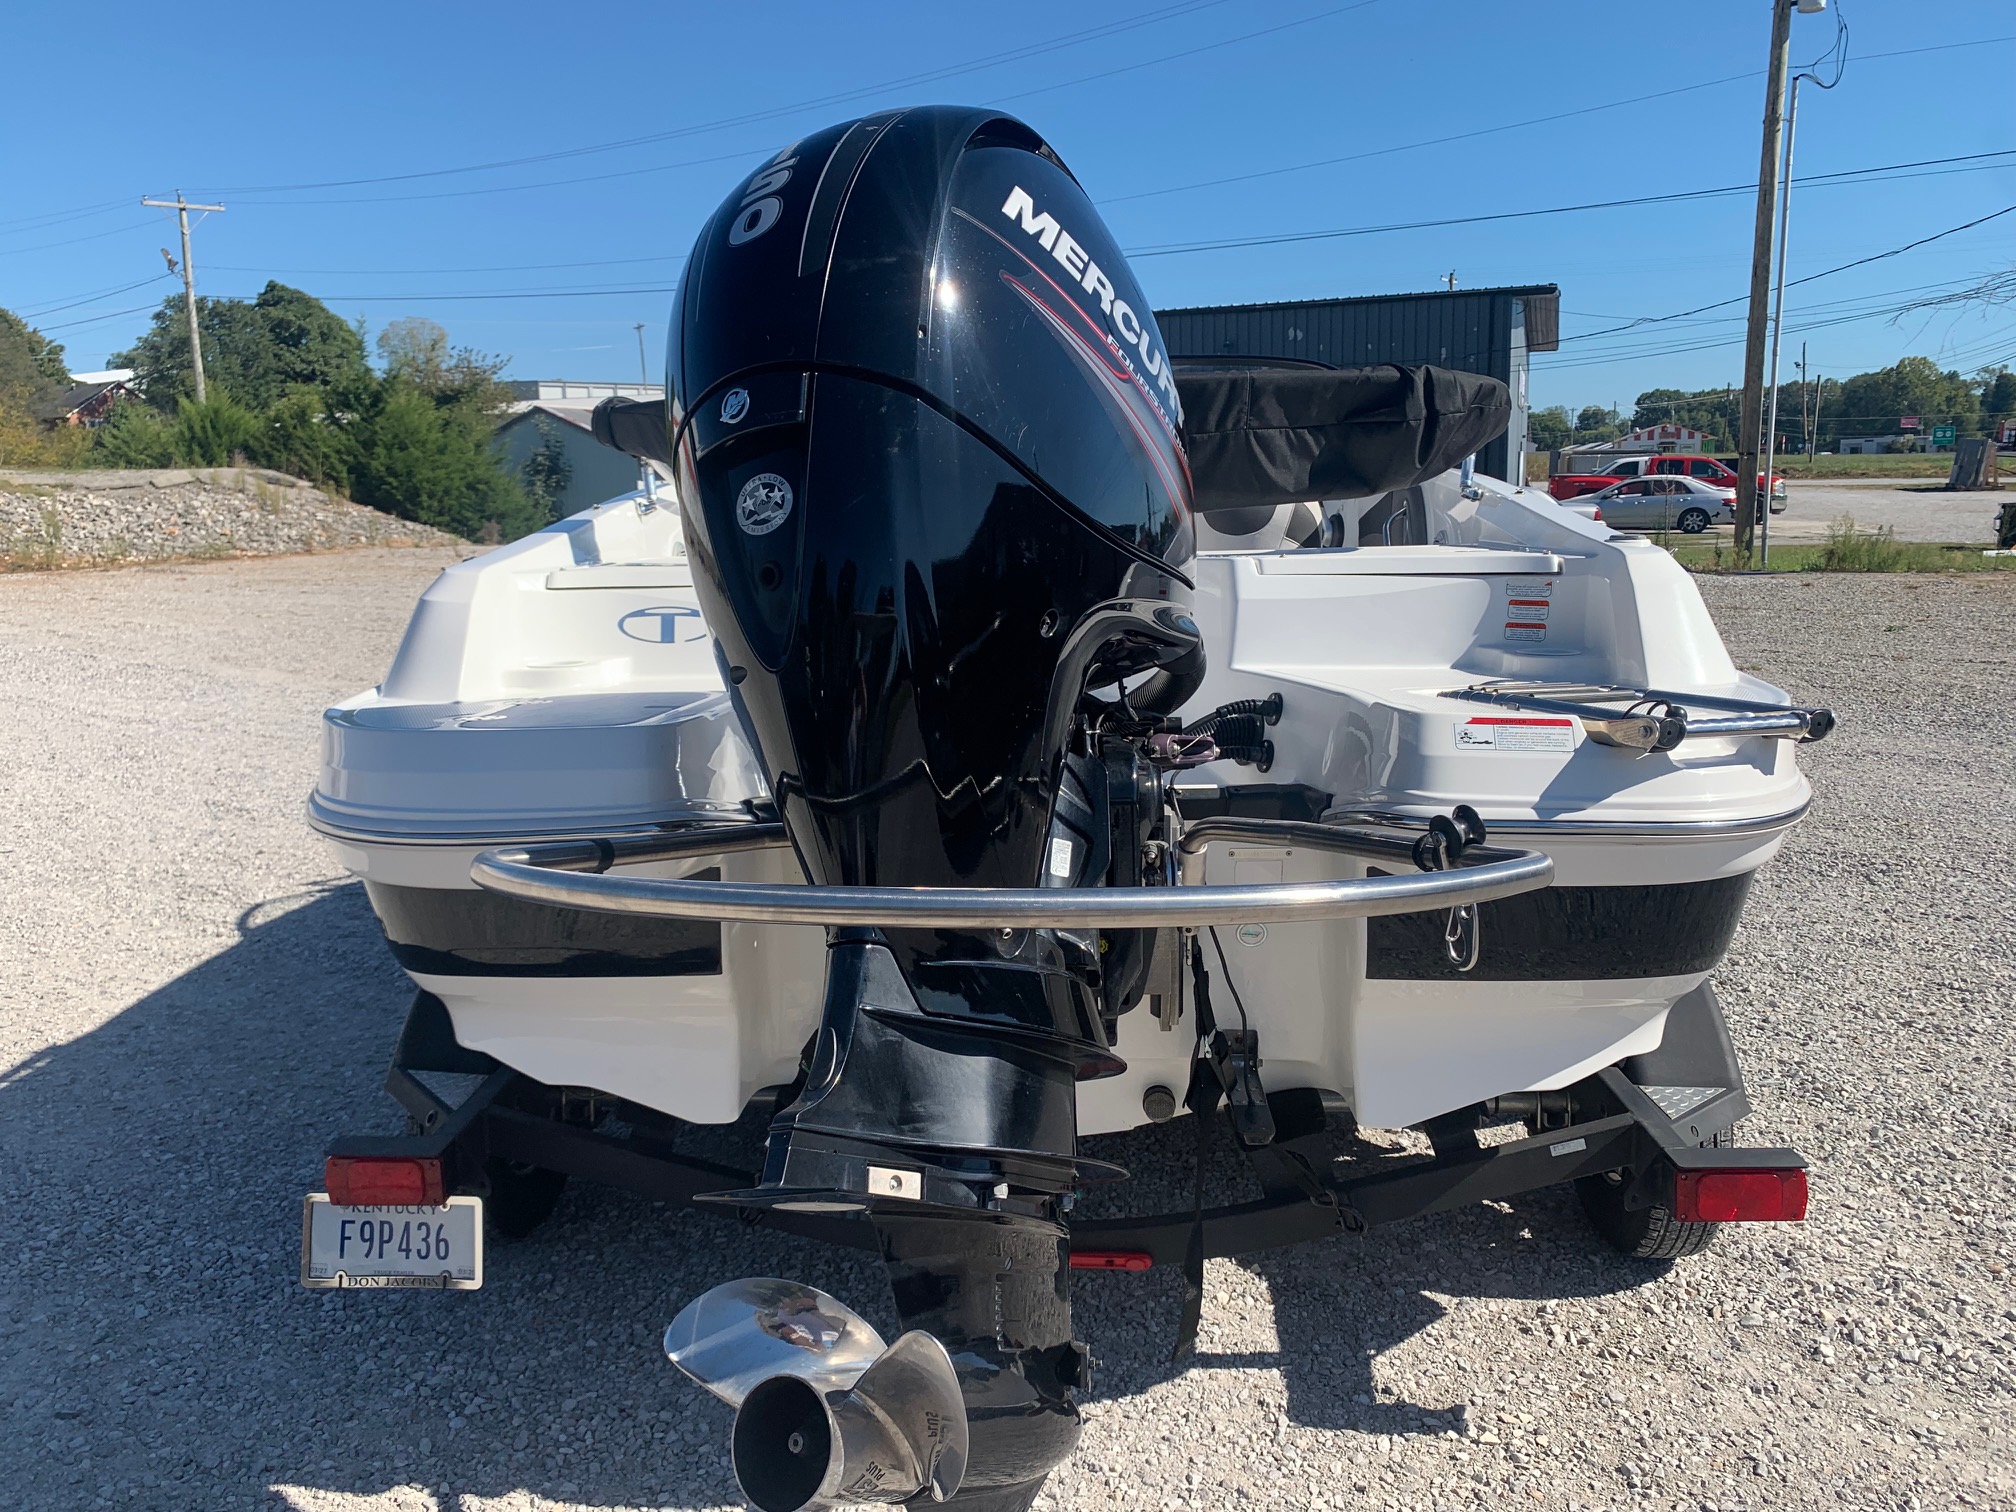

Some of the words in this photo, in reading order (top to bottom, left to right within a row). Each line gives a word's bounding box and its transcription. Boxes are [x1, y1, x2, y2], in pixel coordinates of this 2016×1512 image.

[339, 1219, 450, 1261] F9P436
[348, 1276, 380, 1287] DON
[866, 1461, 886, 1482] PLUS
